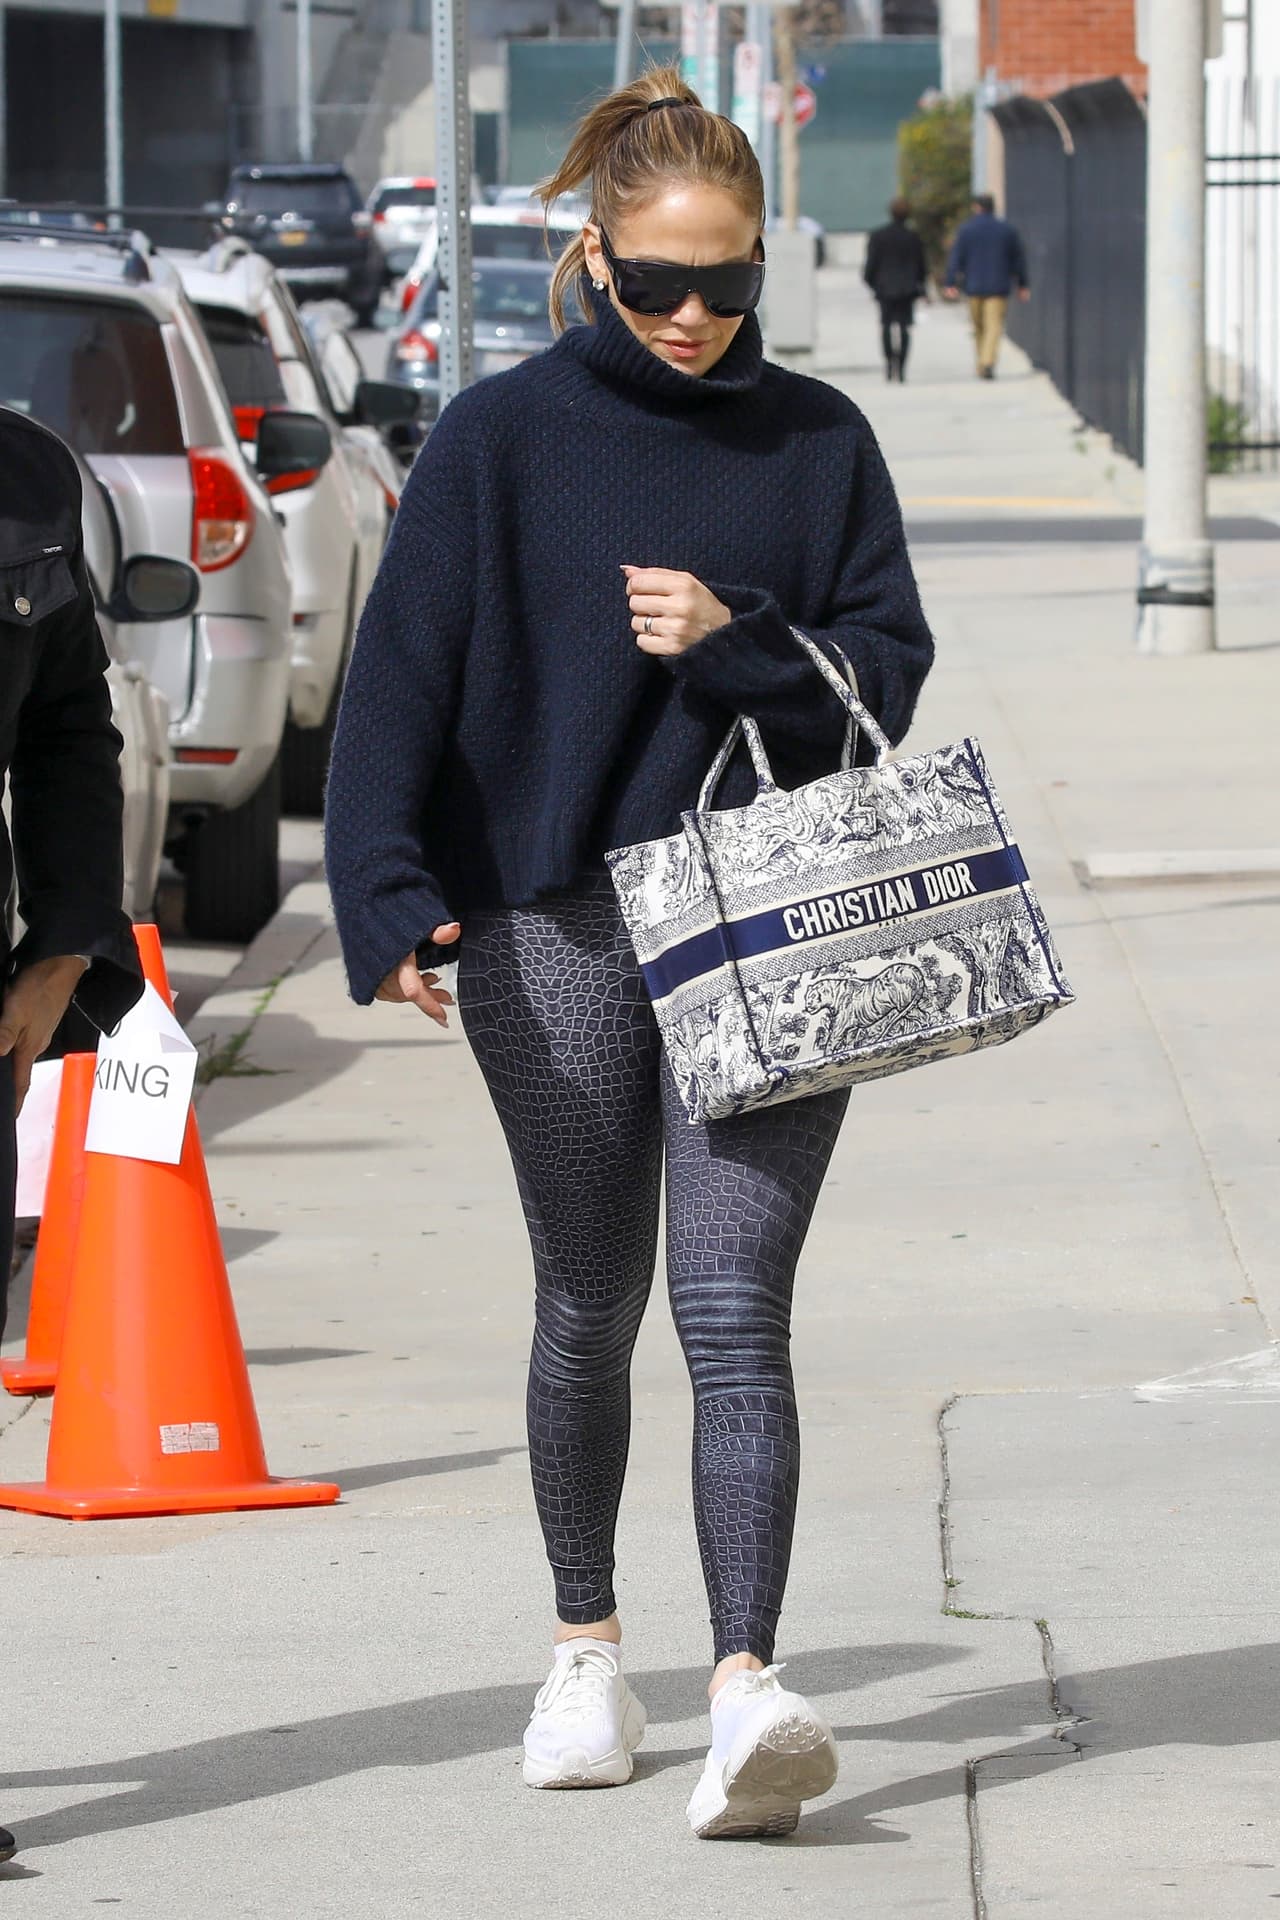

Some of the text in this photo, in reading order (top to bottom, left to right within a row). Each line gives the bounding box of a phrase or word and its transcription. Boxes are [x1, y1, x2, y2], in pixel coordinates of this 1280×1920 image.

[783, 862, 977, 940] CHRISTIAN DIOR
[878, 915, 909, 928] PARIS
